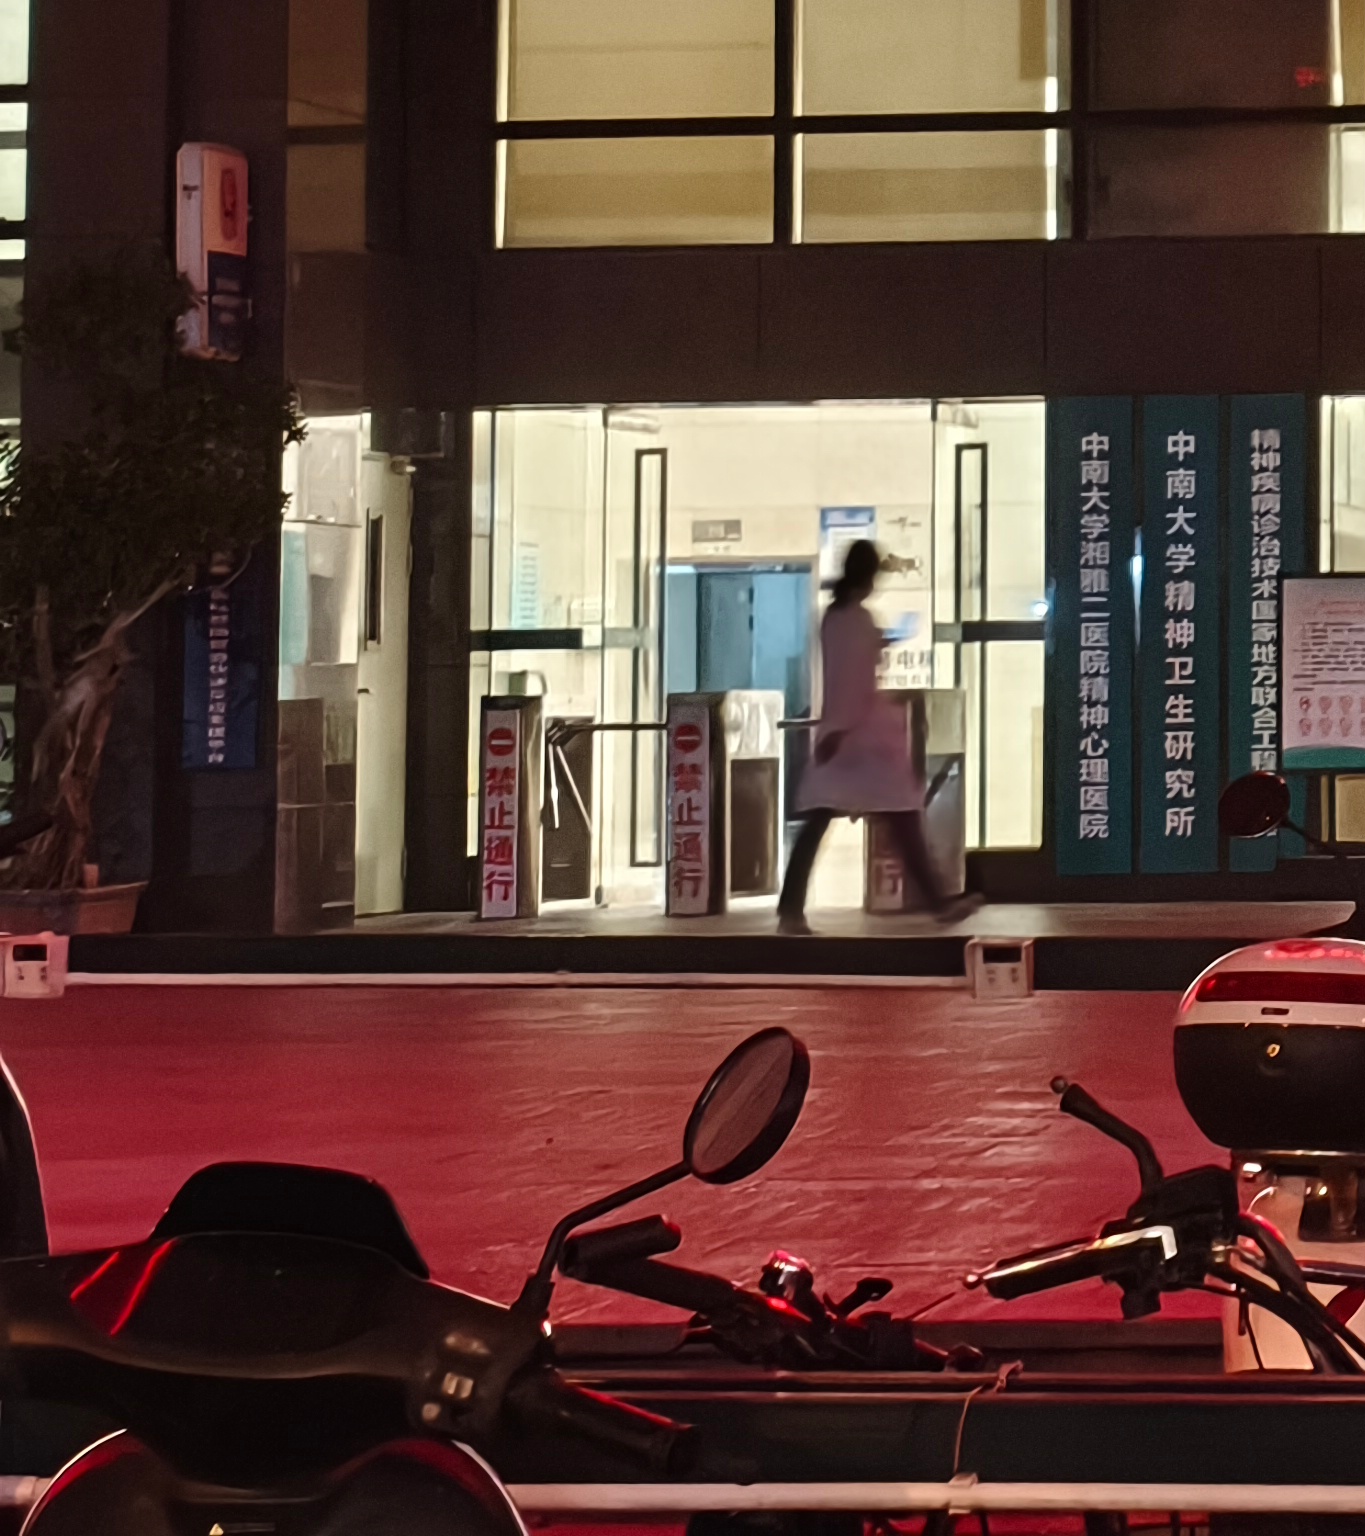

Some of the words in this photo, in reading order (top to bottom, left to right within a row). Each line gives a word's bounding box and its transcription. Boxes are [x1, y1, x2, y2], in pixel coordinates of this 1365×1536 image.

[1164, 429, 1197, 838] 中南大学精神卫生研究所
[1249, 428, 1281, 837] 精神疾病诊治技术国家地方联合工程
[483, 765, 516, 902] 禁止通行
[672, 761, 704, 901] 禁止通行
